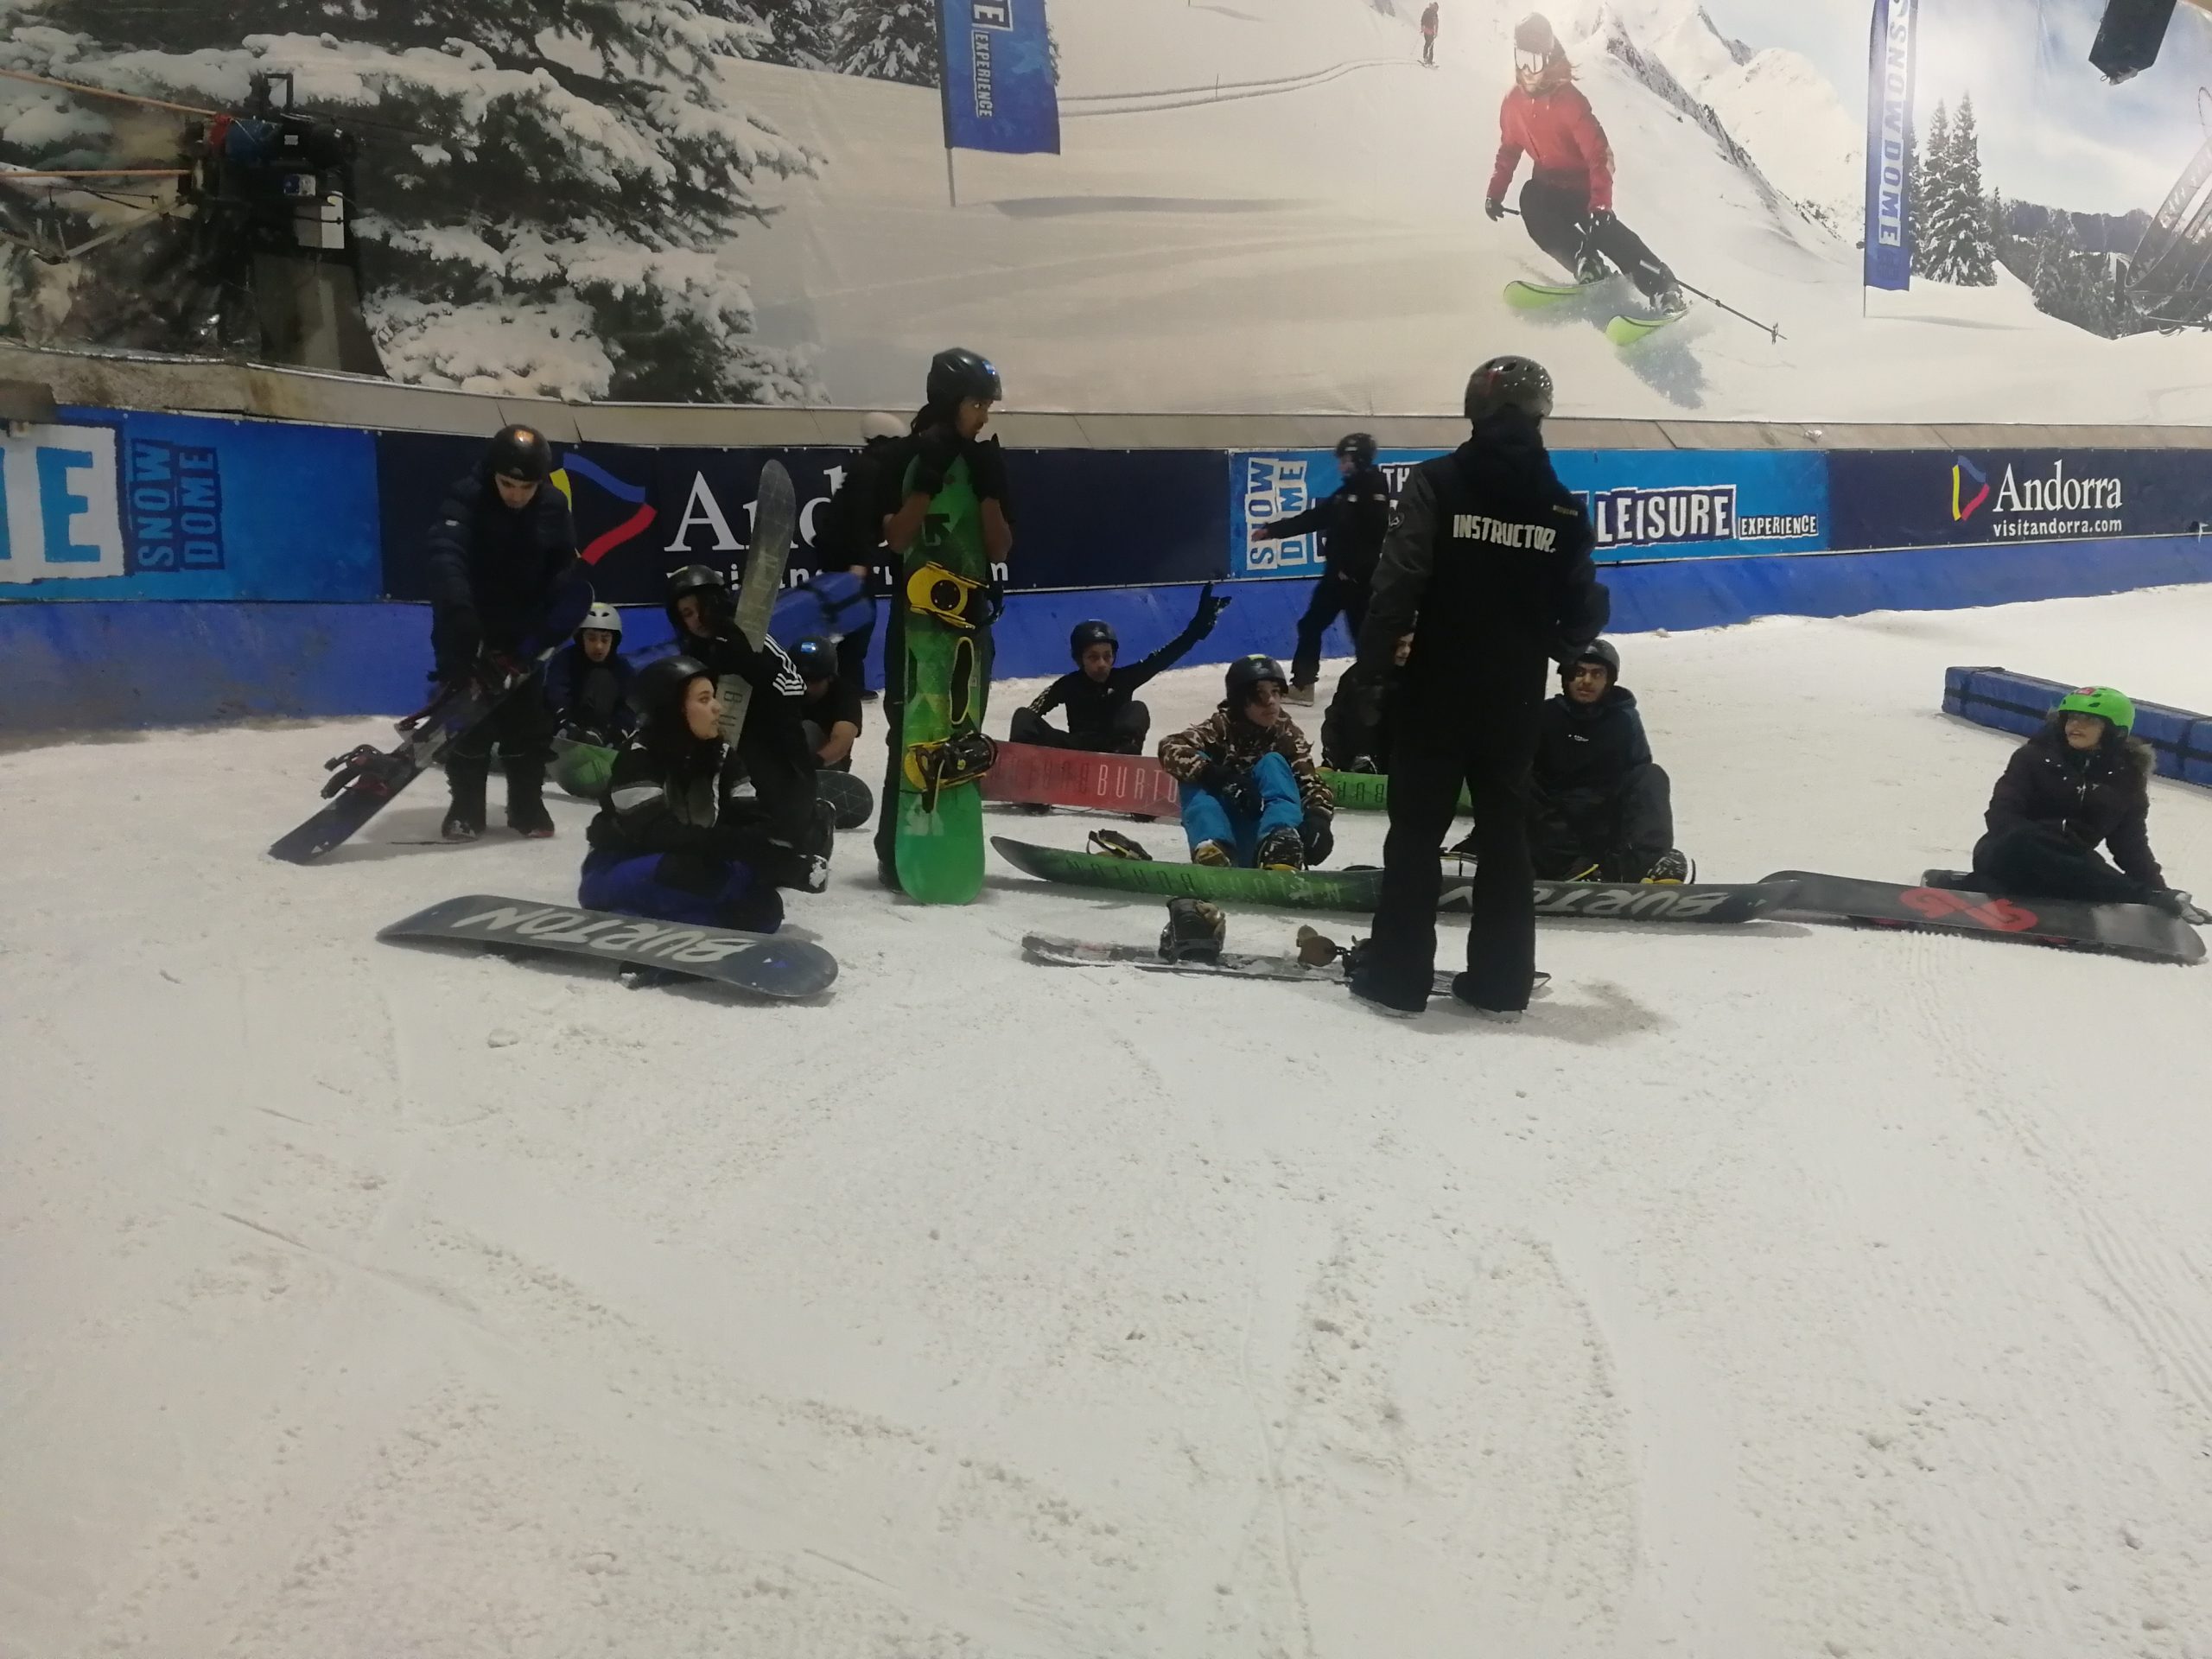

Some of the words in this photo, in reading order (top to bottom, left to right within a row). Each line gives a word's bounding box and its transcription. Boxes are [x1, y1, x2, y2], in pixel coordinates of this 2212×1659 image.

[975, 34, 993, 118] EXPERIENCE
[1880, 22, 1906, 241] SNOWDOME
[133, 442, 175, 567] SNOW
[179, 451, 219, 564] DOME
[1248, 461, 1274, 565] SOW
[1279, 466, 1304, 560] DME
[1382, 467, 1410, 493] TH
[1993, 459, 2123, 512] Andorra
[1597, 493, 1731, 543] LEISURE
[1741, 514, 1816, 536] EXPERIENCE
[1993, 518, 2122, 537] visitandorra.com
[1097, 764, 1179, 804] BURTO
[451, 907, 759, 963] BURTON
